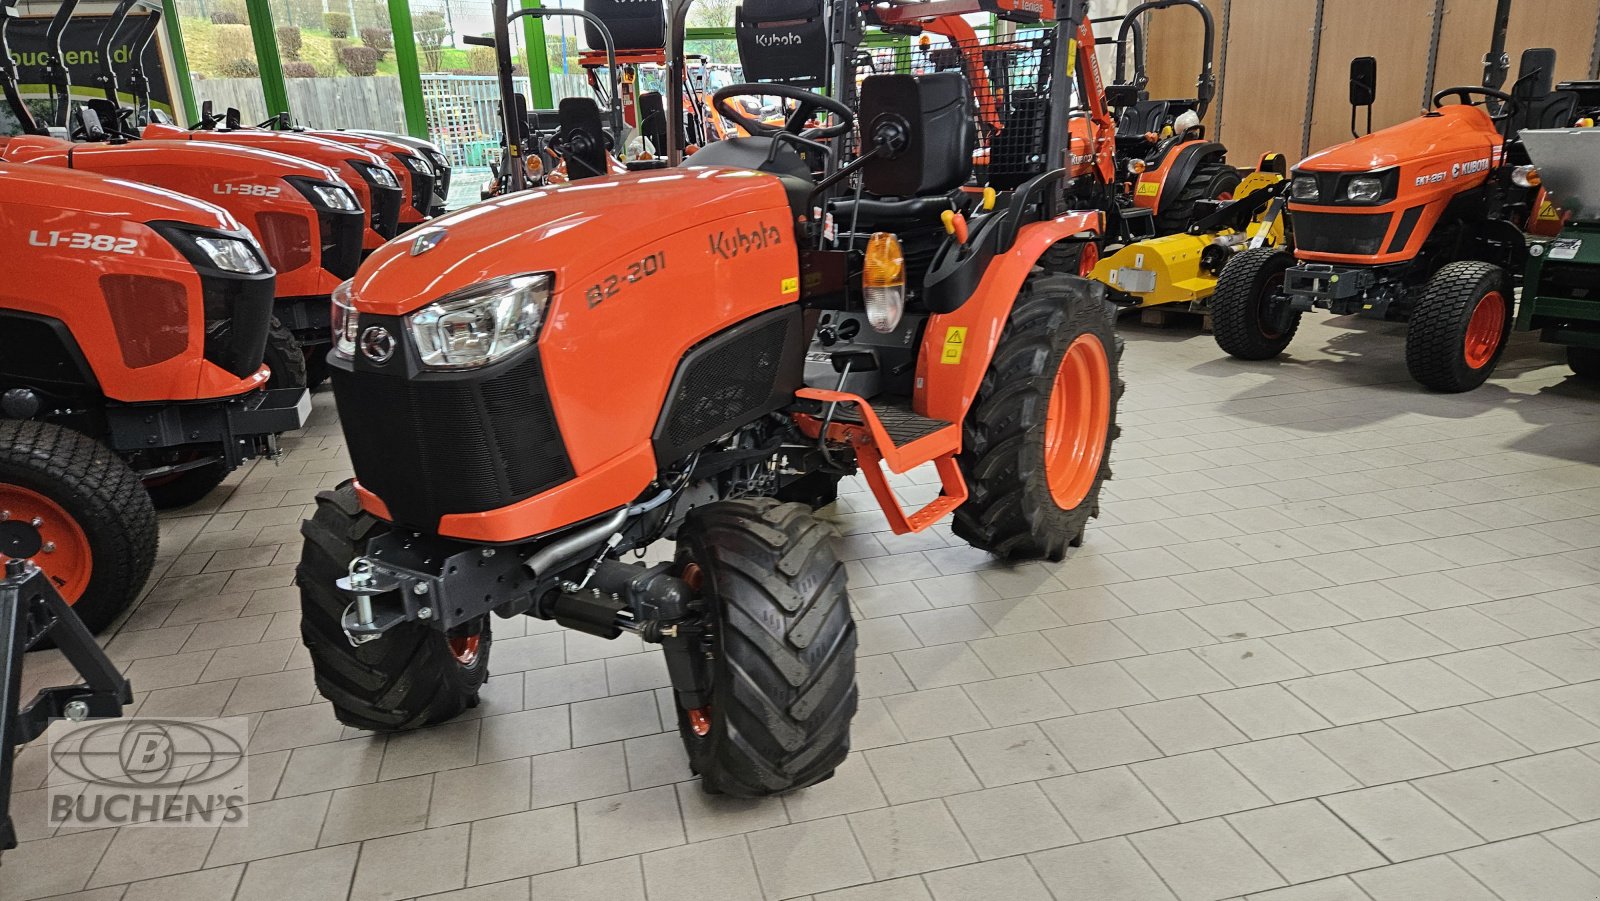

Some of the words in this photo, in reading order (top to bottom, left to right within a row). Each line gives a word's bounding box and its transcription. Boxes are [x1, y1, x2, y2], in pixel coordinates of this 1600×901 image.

[755, 32, 802, 47] Kubota
[8, 45, 132, 67] bucend
[1461, 157, 1489, 175] KUBOTA
[213, 183, 281, 198] L1-382
[28, 230, 138, 255] L1-382
[708, 221, 781, 260] Kubota
[585, 250, 666, 310] B2-201
